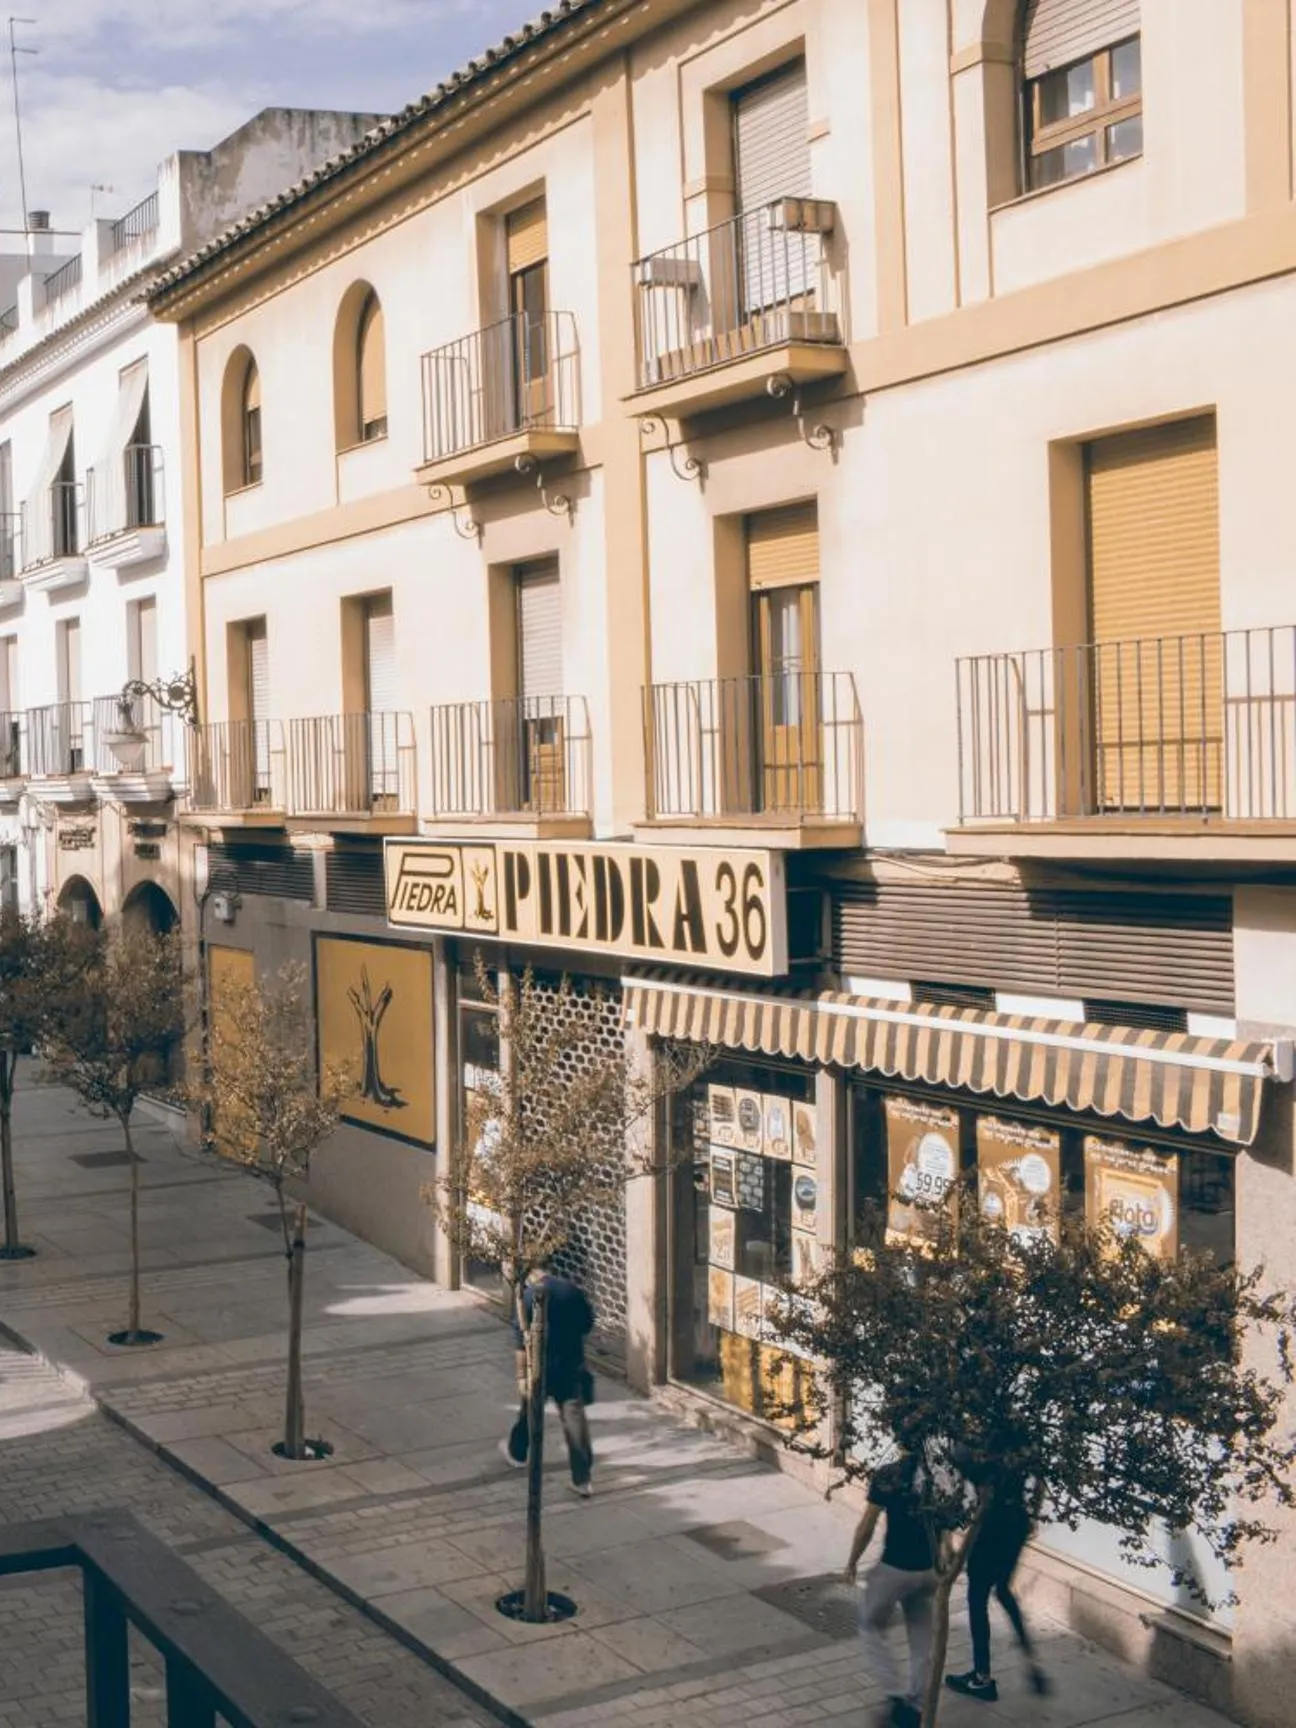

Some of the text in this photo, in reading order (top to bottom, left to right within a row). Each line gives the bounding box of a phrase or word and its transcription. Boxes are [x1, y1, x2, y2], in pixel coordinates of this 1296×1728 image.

[391, 852, 458, 916] PIEDRA
[504, 851, 767, 962] PIEDRA 36
